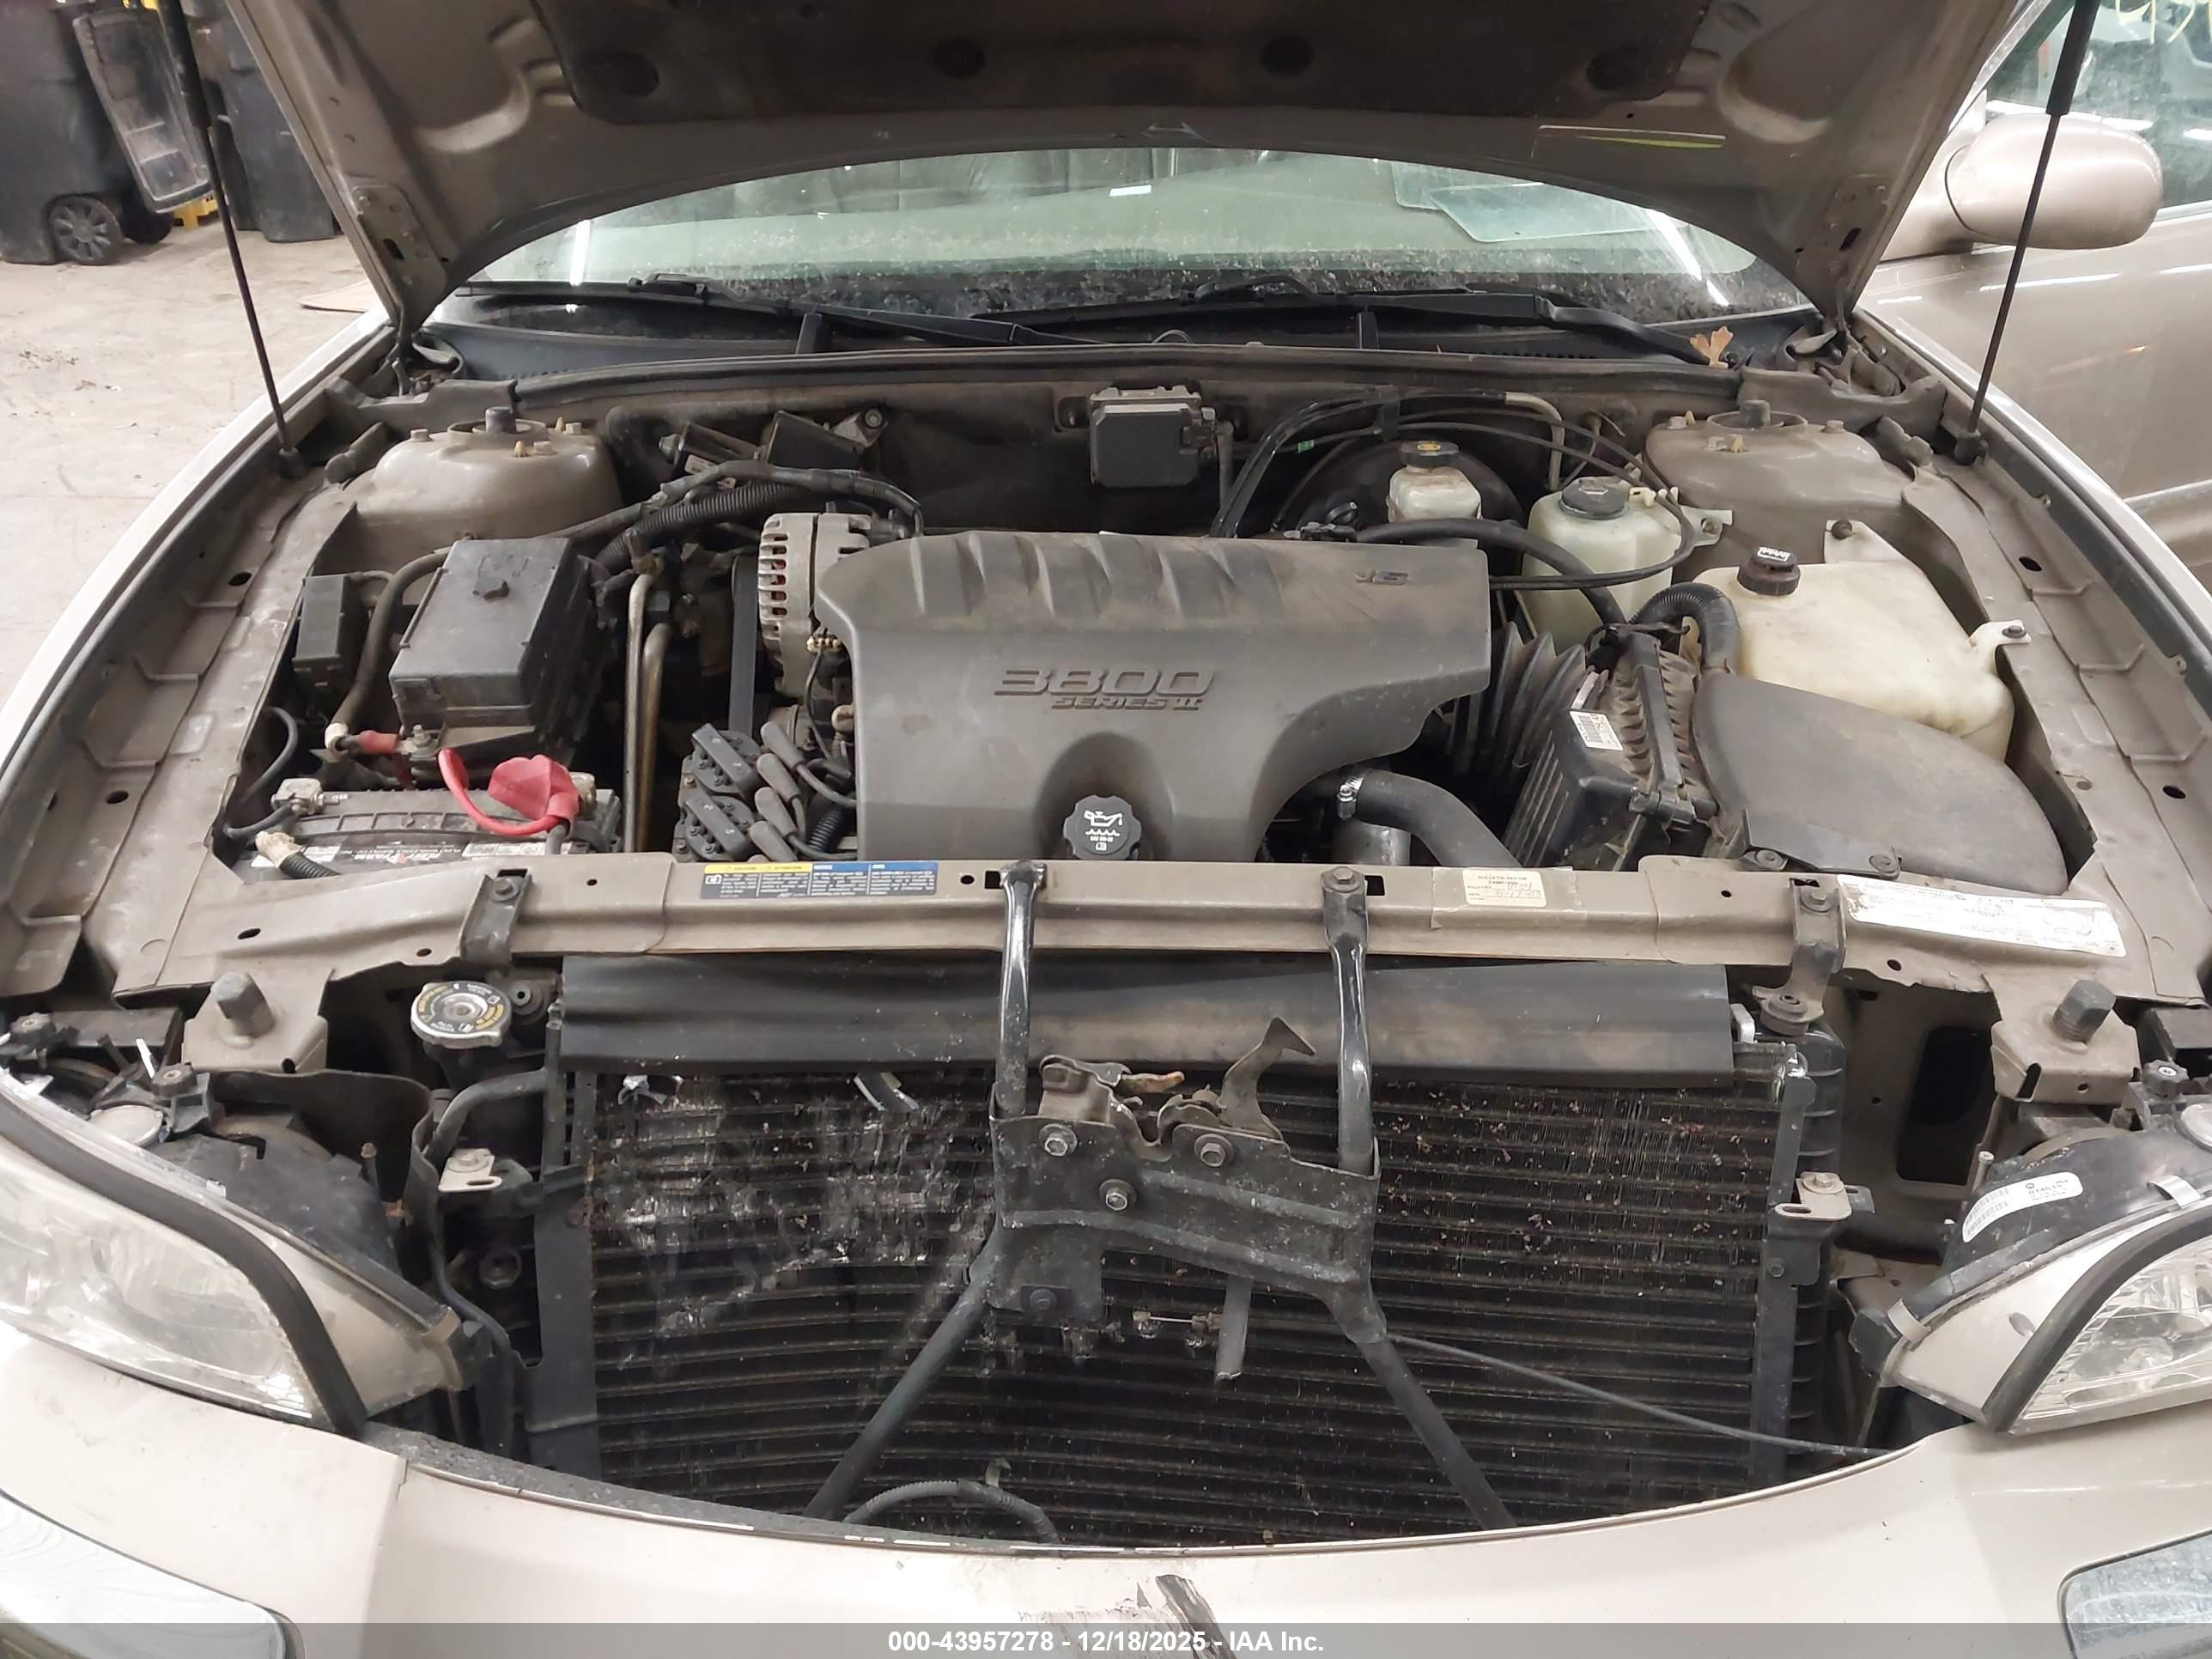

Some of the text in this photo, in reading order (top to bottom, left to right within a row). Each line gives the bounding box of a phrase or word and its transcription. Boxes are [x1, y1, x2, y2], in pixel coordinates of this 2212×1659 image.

[994, 668, 1216, 696] 3800
[1051, 696, 1203, 711] SERIES II
